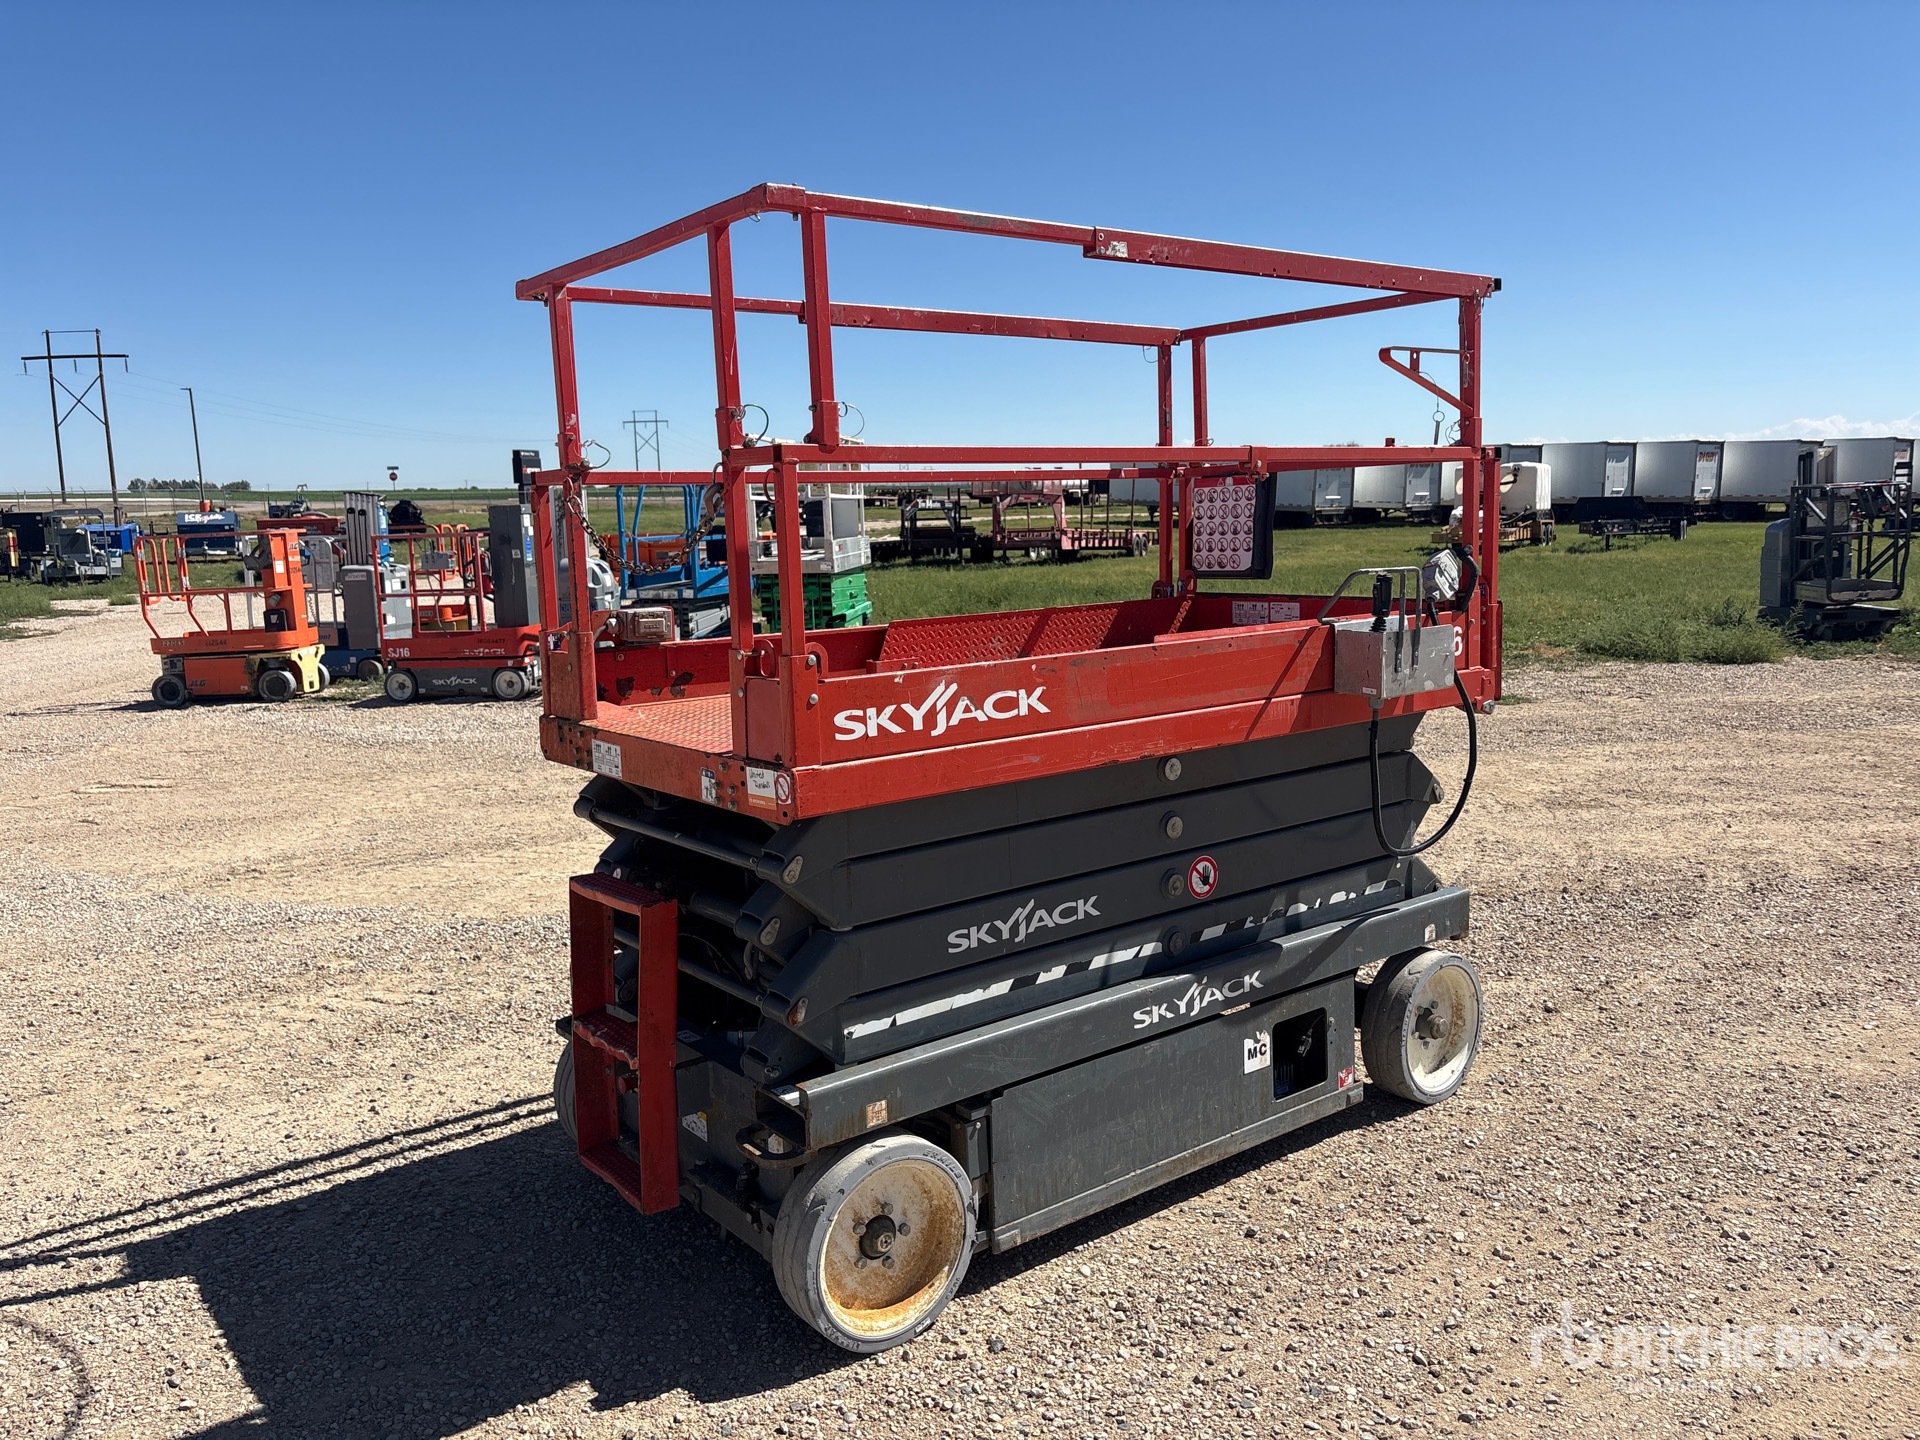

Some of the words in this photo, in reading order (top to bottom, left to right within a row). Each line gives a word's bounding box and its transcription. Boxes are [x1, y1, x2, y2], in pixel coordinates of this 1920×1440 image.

[387, 647, 411, 658] SJ16
[190, 679, 207, 687] JLG
[432, 675, 478, 686] SKYJACK
[833, 680, 1052, 741] SKYJACK
[947, 895, 1101, 953] SKYJACK
[1133, 970, 1264, 1029] SKYJACK
[1247, 1043, 1268, 1061] MC
